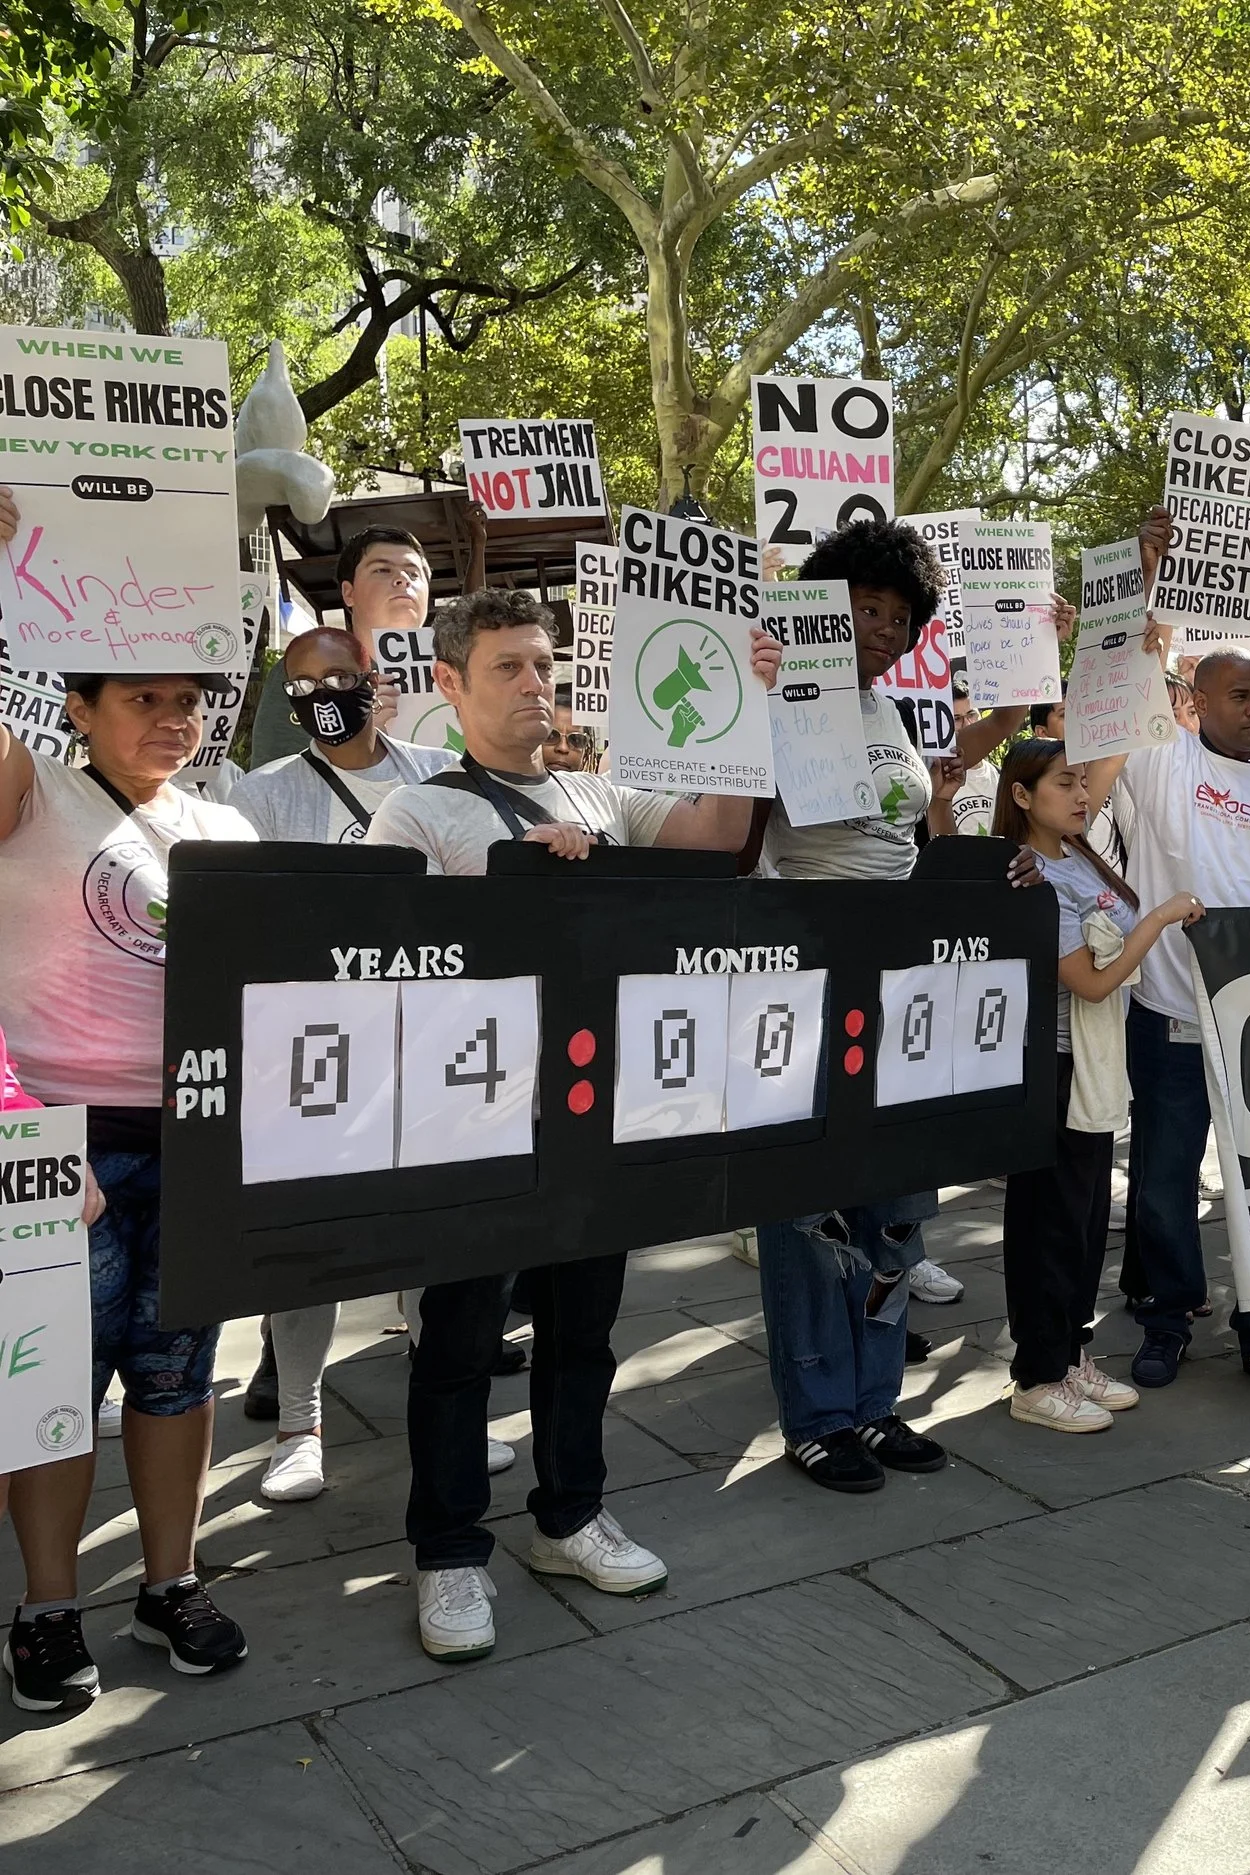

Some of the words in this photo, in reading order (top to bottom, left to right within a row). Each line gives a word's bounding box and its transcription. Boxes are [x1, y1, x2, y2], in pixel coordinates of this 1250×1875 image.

[16, 338, 131, 362] WHEN
[130, 346, 184, 366] WE
[0, 374, 94, 421] LOSE
[104, 380, 228, 429] RIKERS
[757, 383, 889, 439] NO
[67, 441, 156, 461] YORK
[162, 447, 229, 464] CITY
[463, 422, 595, 459] TREATMENT
[757, 446, 890, 484] GIULIANI
[78, 481, 121, 496] WILL
[127, 484, 147, 497] BE
[469, 468, 531, 511] NOT
[535, 463, 600, 508] JAIL
[624, 512, 759, 580] CLOSE
[974, 528, 1012, 537] WHEN
[1016, 529, 1034, 537] WE
[962, 548, 1003, 571] CLOSE
[1007, 547, 1050, 571] RIKERS
[1094, 551, 1119, 566] WHEN
[1120, 548, 1132, 559] WE
[6, 526, 214, 622] Kinder
[622, 556, 760, 619] RIKERS
[963, 581, 989, 590] NEW
[993, 581, 1025, 589] YORK
[1028, 581, 1051, 589] CITY
[1083, 576, 1115, 608] CLOSE
[1116, 567, 1143, 600] RIKERS
[801, 589, 828, 600] WE
[795, 614, 851, 645] RIKERS
[1081, 617, 1105, 631] NEW
[1105, 611, 1130, 624] YORK
[780, 660, 820, 672] YORK
[823, 657, 854, 669] CITY
[784, 689, 805, 697] WILL
[808, 687, 818, 696] BE
[619, 756, 706, 772] DECARCERATE
[720, 764, 767, 777] DEFEND
[620, 768, 664, 782] DIVEST
[668, 773, 677, 783] &
[681, 774, 767, 789] REDISTRIBUTE
[97, 871, 129, 937] DECARCERATE
[331, 944, 464, 981] YEARS
[676, 945, 799, 974] MONTHS
[933, 937, 989, 963] DAYS
[176, 1048, 227, 1084] AM
[176, 1086, 226, 1119] PM
[0, 1154, 82, 1206] KERS
[13, 1218, 80, 1241] CITY
